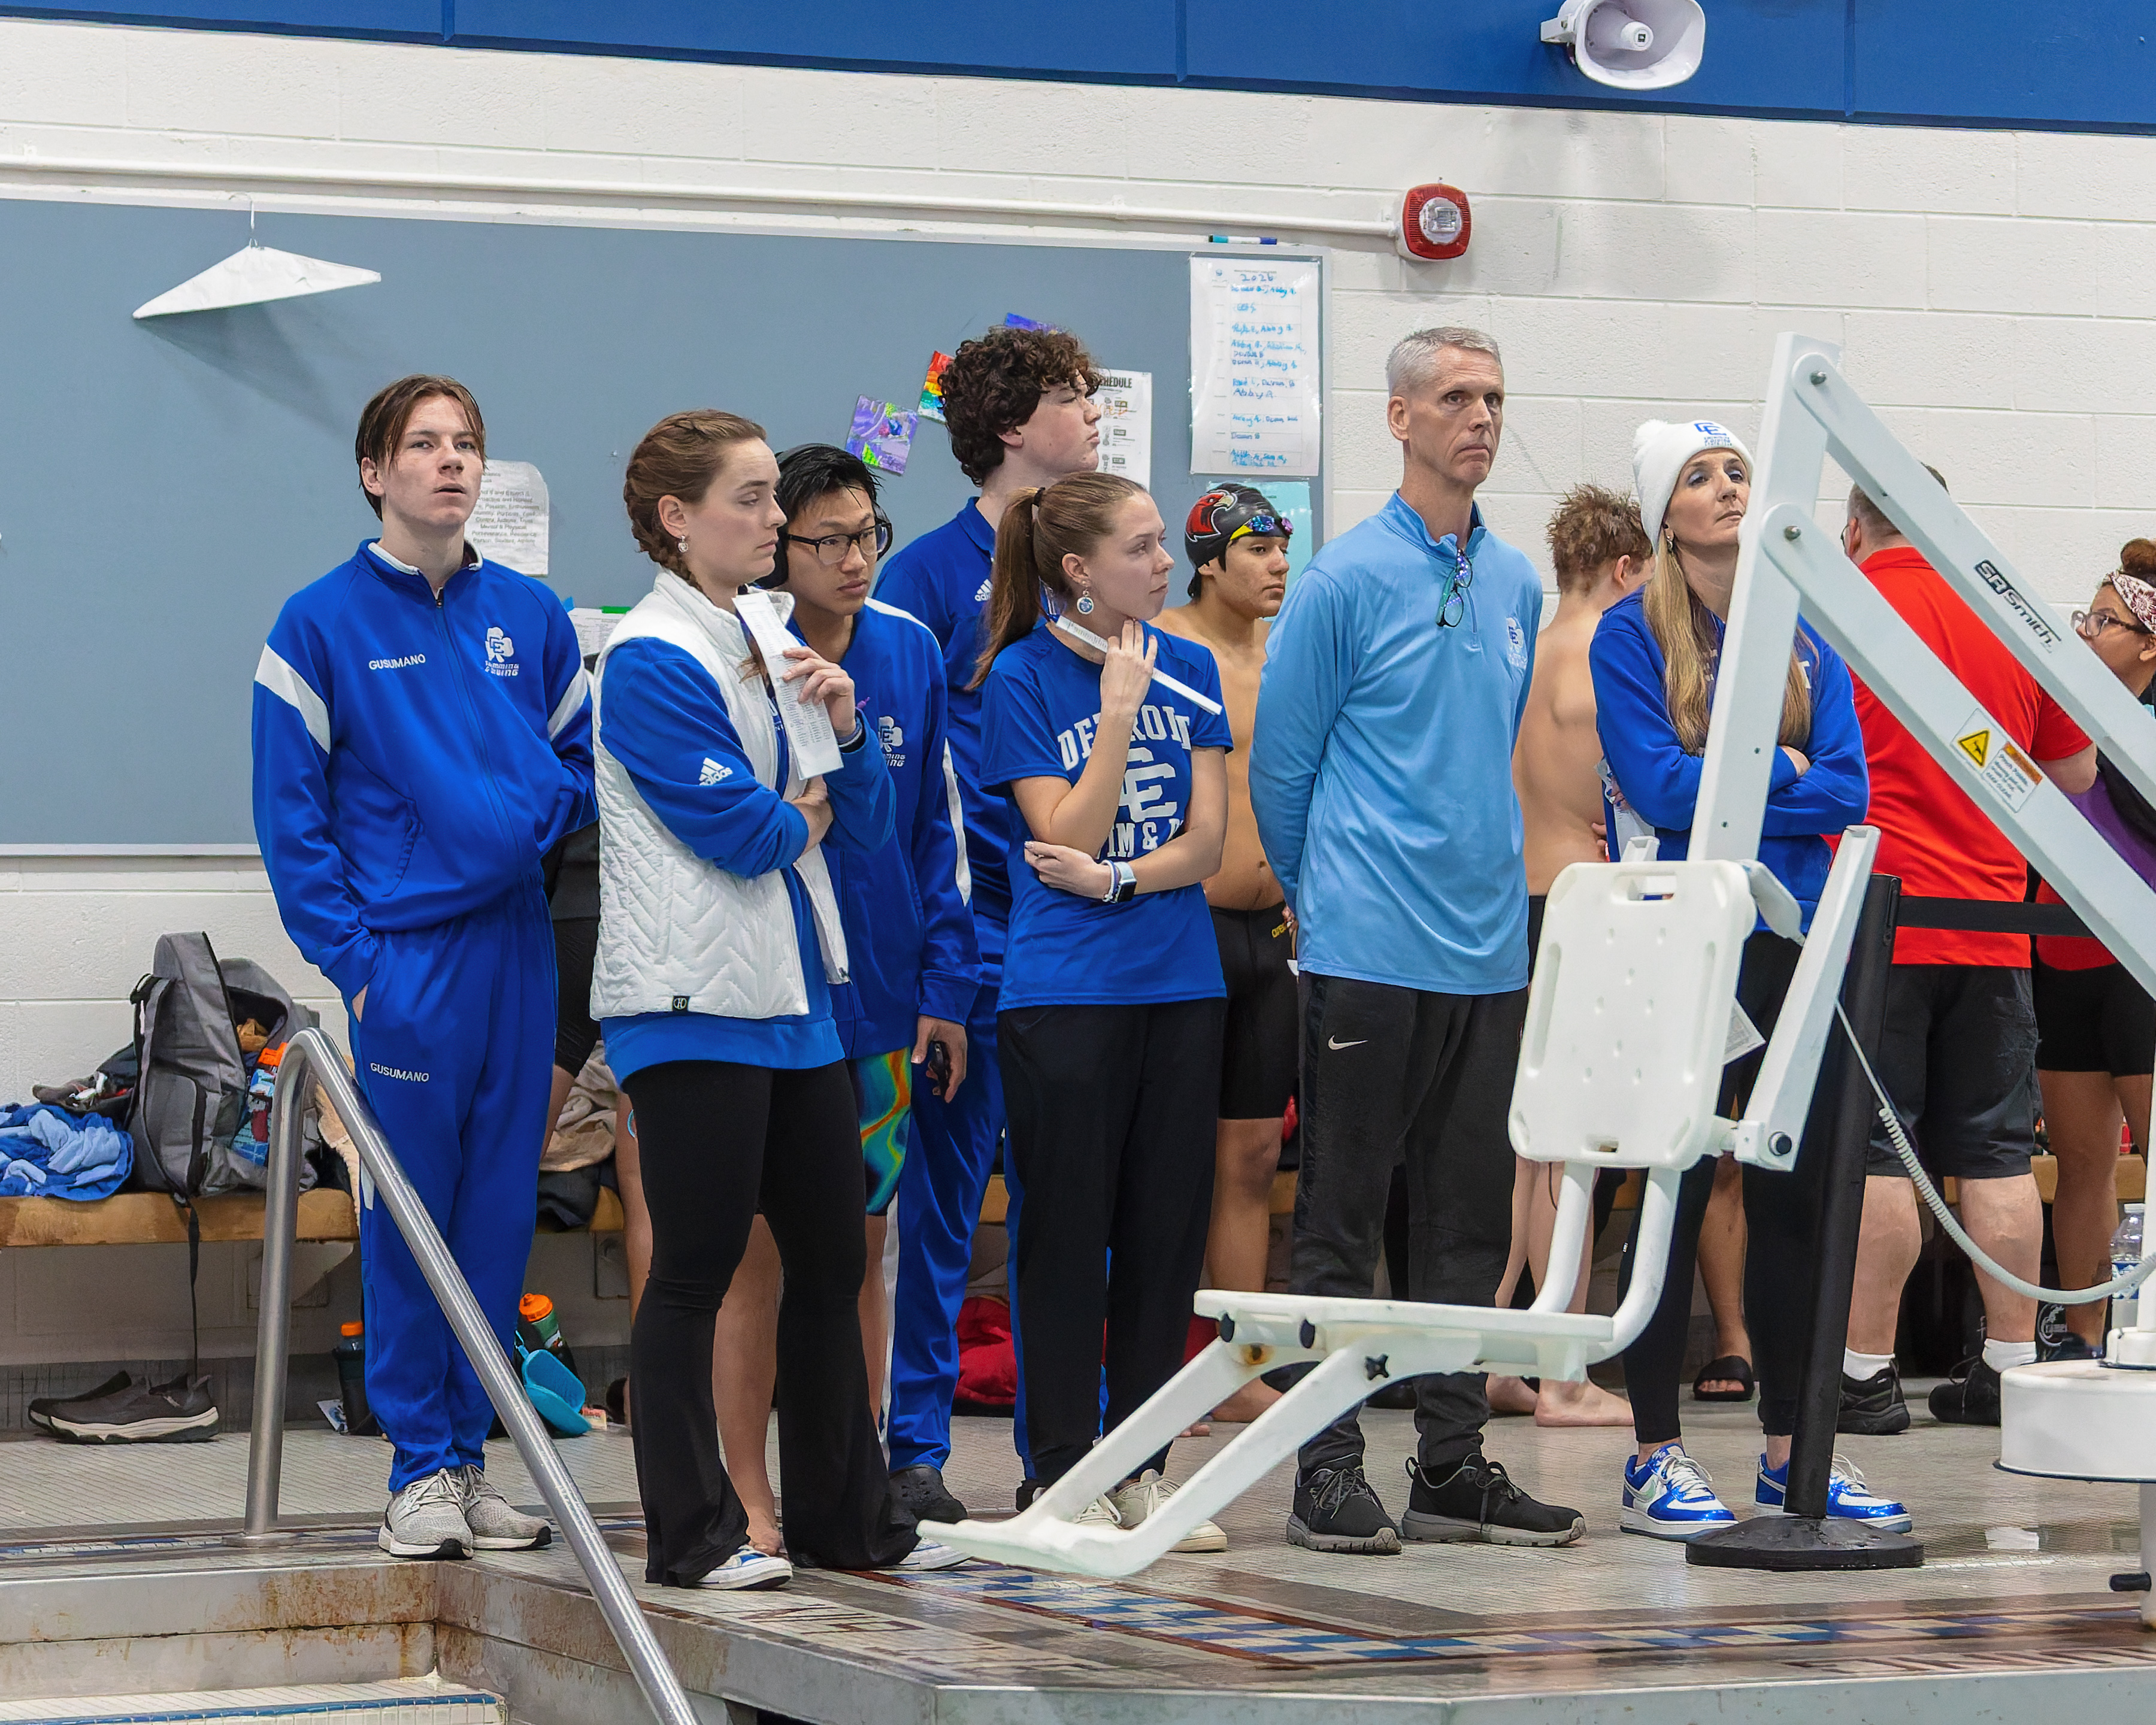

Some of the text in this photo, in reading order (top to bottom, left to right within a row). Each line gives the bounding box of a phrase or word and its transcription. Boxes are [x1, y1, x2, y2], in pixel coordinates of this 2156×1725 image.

[1101, 376, 1132, 389] HEDULE
[368, 653, 426, 671] GUSUMANO
[1141, 821, 1158, 850] &
[370, 1062, 429, 1082] GUSUMANO
